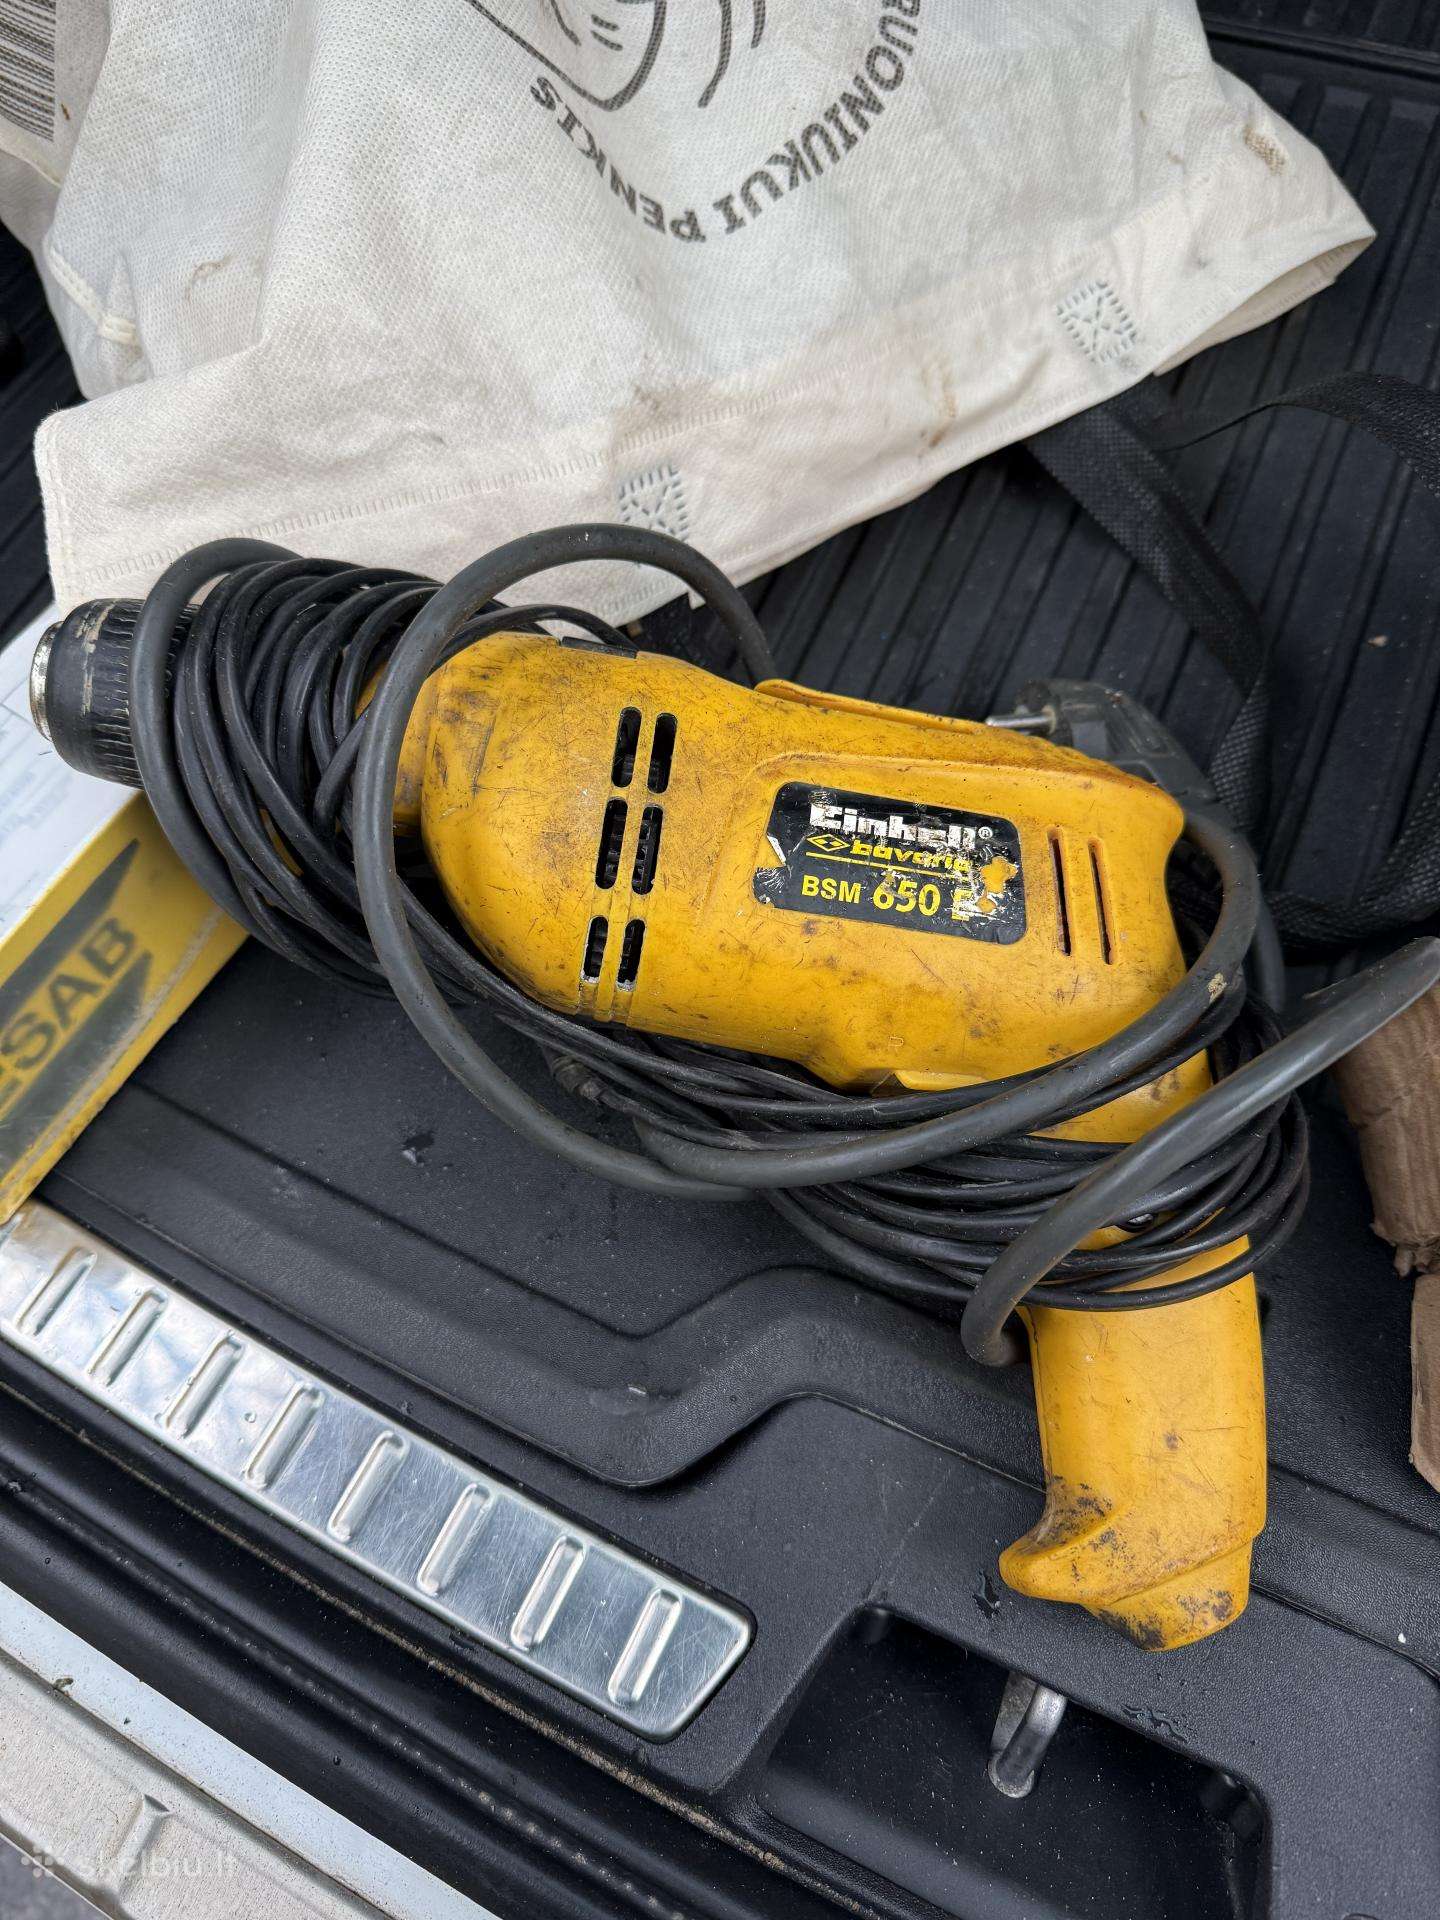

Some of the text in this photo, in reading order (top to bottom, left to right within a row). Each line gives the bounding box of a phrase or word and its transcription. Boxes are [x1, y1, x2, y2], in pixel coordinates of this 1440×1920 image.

[530, 77, 706, 243] PENKIS
[801, 874, 862, 904] BSM
[872, 876, 941, 916] 650
[0, 917, 136, 1105] SAB
